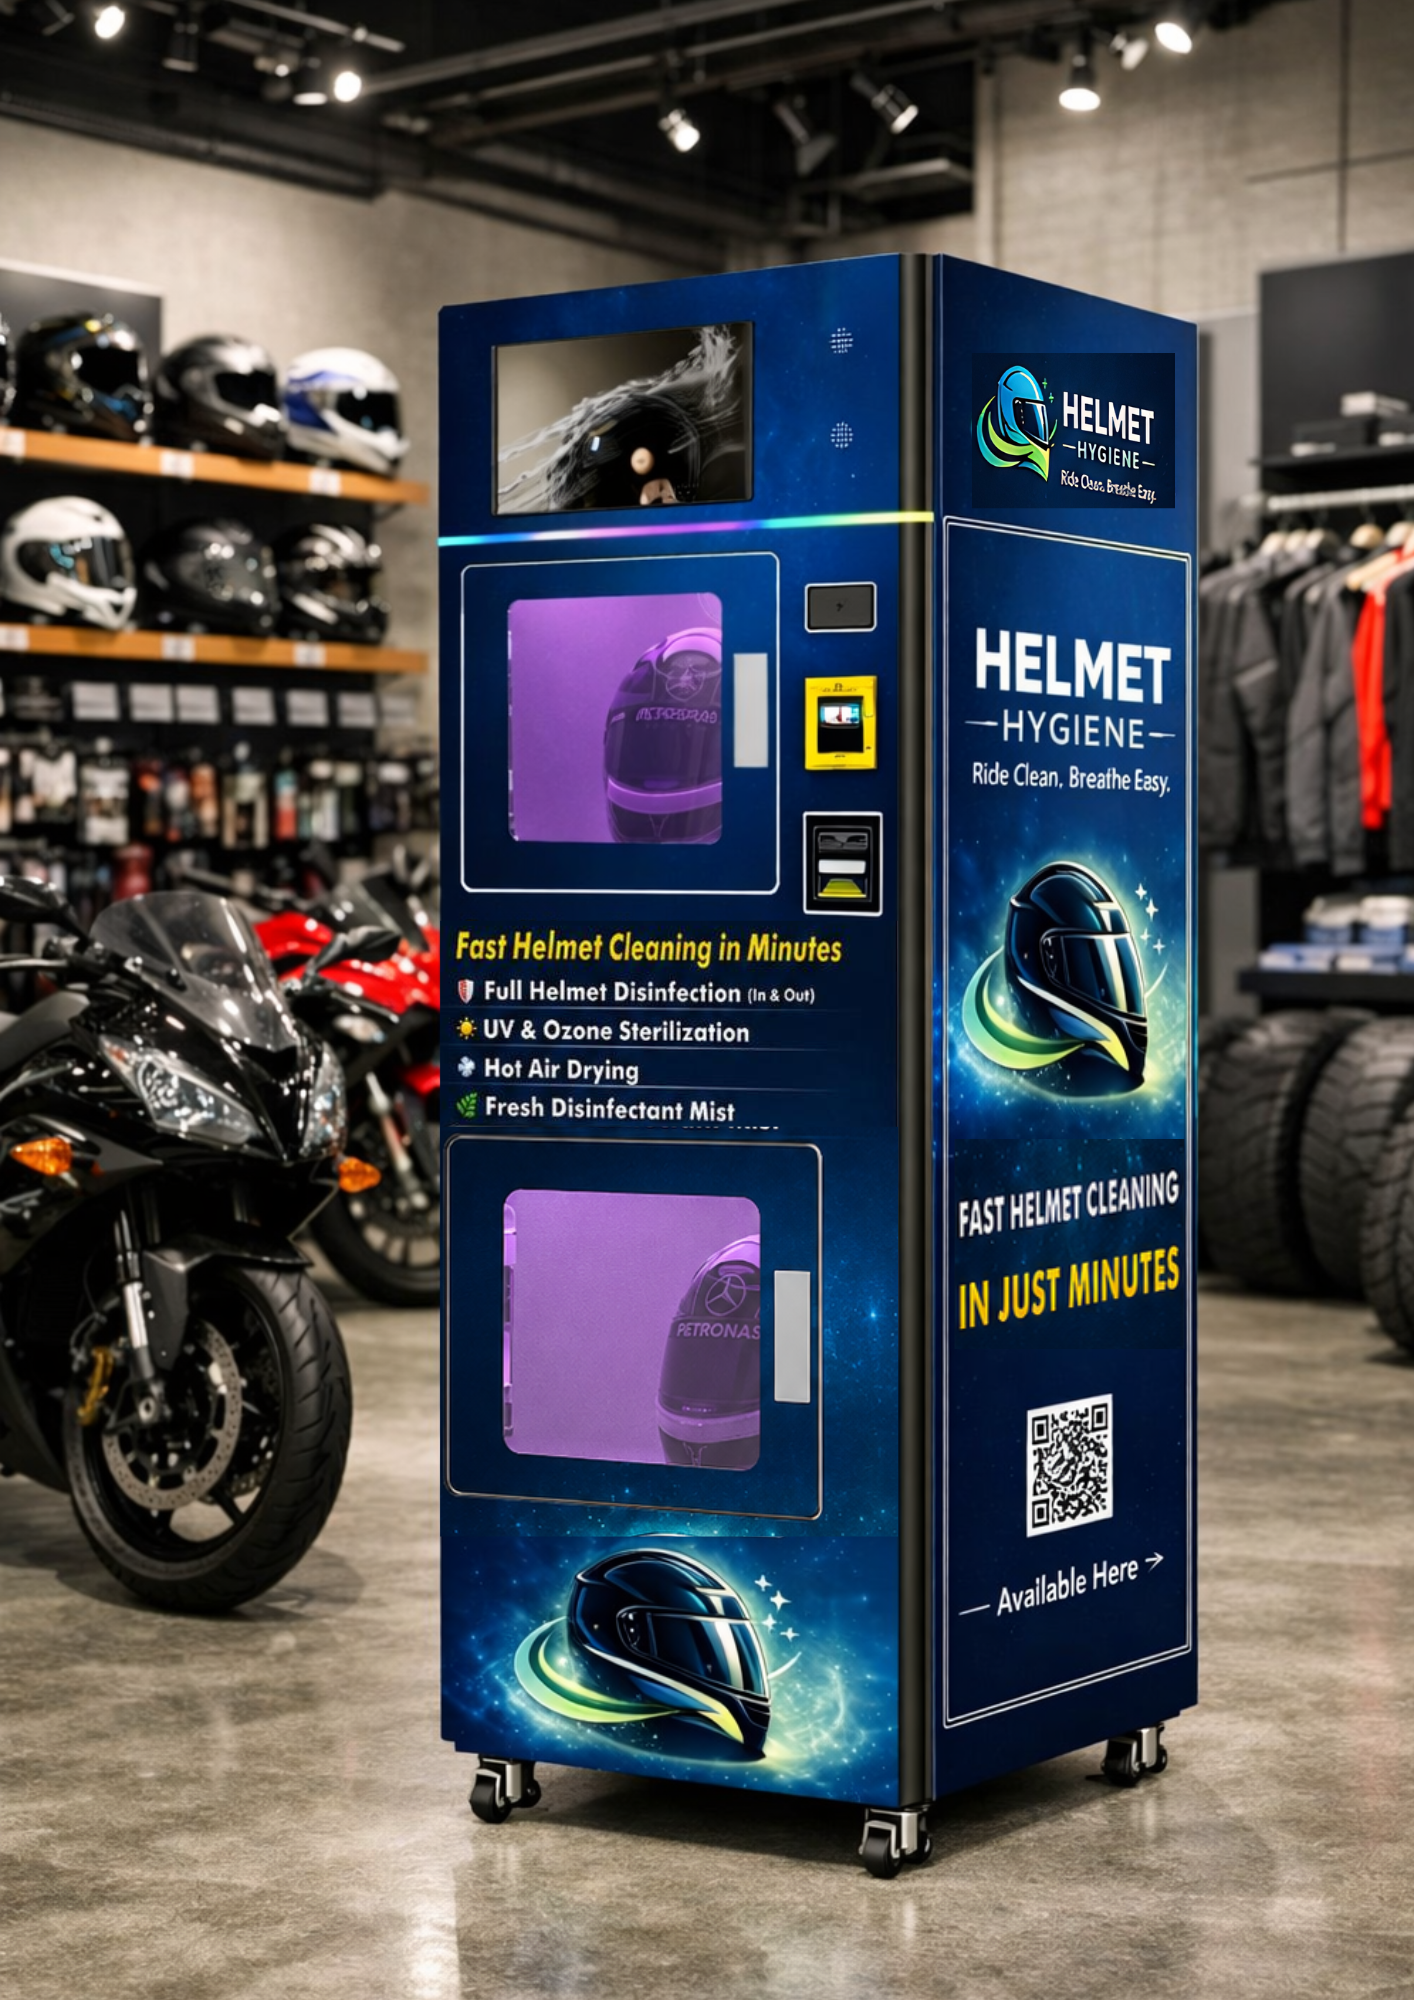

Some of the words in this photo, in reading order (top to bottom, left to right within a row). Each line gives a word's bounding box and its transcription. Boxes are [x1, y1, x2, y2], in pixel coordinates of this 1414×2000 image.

[1062, 391, 1155, 445] HELMET
[1077, 440, 1140, 470] HYGIENE
[976, 627, 1172, 705] HELMET
[1003, 709, 1144, 749] HYGIENE
[972, 762, 1009, 786] Ride
[1069, 765, 1131, 790] Breathe
[1134, 769, 1171, 798] Easy.
[456, 931, 508, 960] Fast
[512, 929, 603, 961] Helmet
[608, 931, 712, 970] Cleaning
[719, 932, 741, 962] in
[747, 932, 843, 963] Minutes
[484, 979, 523, 1001] Full
[529, 979, 607, 1002] Helmet
[614, 980, 741, 1003] Disinfection
[747, 987, 766, 1005] (In
[769, 988, 781, 1002] &
[783, 987, 815, 1005] Out)
[483, 1019, 515, 1039] UV
[520, 1019, 537, 1040] &
[543, 1019, 613, 1041] Ozone
[618, 1020, 750, 1043] Sterilization
[484, 1058, 522, 1079] Hot
[528, 1058, 561, 1079] Air
[567, 1059, 640, 1086] Drying
[485, 1096, 545, 1118] Fresh
[551, 1098, 683, 1121] Disinfectant
[689, 1101, 736, 1122] Mist
[958, 1196, 1005, 1239] FAST
[1010, 1185, 1082, 1231] HELMET
[1086, 1169, 1180, 1218] CLEANING
[958, 1280, 990, 1330] IN
[998, 1266, 1061, 1323] JUST
[1068, 1245, 1180, 1309] MINUTES
[676, 1322, 760, 1340] PETRONAS
[996, 1566, 1087, 1617] Available
[1092, 1559, 1139, 1590] Here
